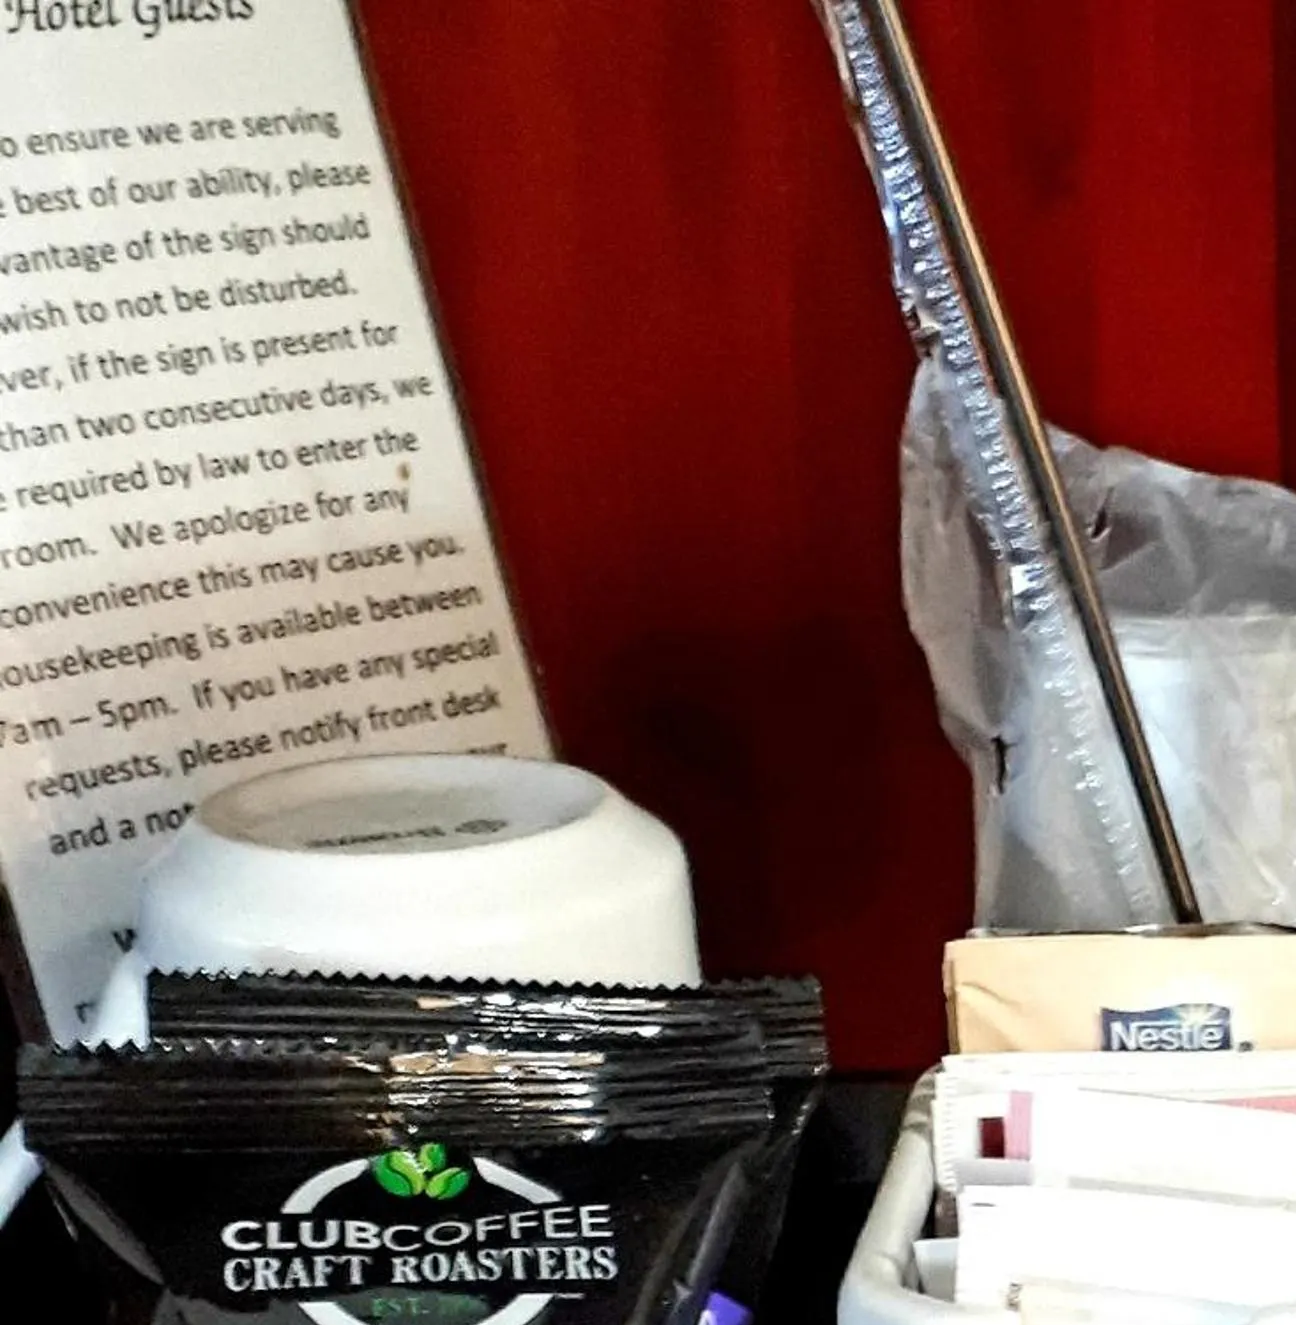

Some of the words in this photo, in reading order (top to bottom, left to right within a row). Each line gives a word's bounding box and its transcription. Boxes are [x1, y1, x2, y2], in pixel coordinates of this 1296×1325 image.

[5, 0, 121, 34] Hotel
[132, 0, 255, 40] Guests
[0, 137, 18, 158] o
[26, 127, 130, 155] ensure
[137, 123, 182, 145] we
[190, 118, 236, 141] are
[242, 107, 341, 139] serving
[12, 187, 82, 214] best
[89, 177, 117, 207] of
[128, 180, 176, 204] our
[187, 168, 281, 198] ability,
[287, 163, 370, 195] please
[0, 243, 117, 275] vantage
[126, 230, 153, 261] of
[162, 229, 212, 257] the
[219, 224, 275, 255] sign
[282, 213, 370, 245] should
[74, 294, 108, 325] to
[115, 291, 167, 318] not
[172, 286, 211, 312] be
[219, 269, 358, 307] disturbed.
[0, 366, 63, 394] ver,
[68, 353, 88, 383] if
[97, 350, 148, 379] the
[156, 344, 215, 375] sign
[220, 337, 246, 363] is
[252, 327, 357, 365] present
[361, 320, 397, 346] for
[76, 413, 136, 439] two
[144, 388, 314, 430] consecutive
[320, 381, 388, 408] days,
[393, 377, 431, 397] we
[15, 462, 149, 507] required
[153, 460, 191, 488] by
[198, 453, 250, 479] law
[256, 449, 289, 472] to
[295, 439, 367, 466] enter
[373, 428, 420, 456] the
[0, 537, 97, 569] room.
[110, 521, 166, 549] We
[174, 501, 311, 544] apologize
[315, 491, 354, 518] for
[364, 489, 408, 513] any
[197, 564, 253, 594] this
[258, 550, 318, 583] may
[327, 544, 404, 573] cause
[407, 537, 463, 565] you.
[0, 633, 202, 688] ousekeeping
[205, 624, 230, 649] is
[237, 602, 361, 644] available
[366, 586, 481, 621] between
[96, 696, 178, 730] 5pm.
[192, 679, 212, 709] If
[219, 678, 275, 710] you
[281, 664, 350, 691] have
[358, 655, 404, 679] any
[411, 632, 498, 672] special
[25, 756, 172, 800] requests,
[178, 734, 272, 778] please
[279, 711, 360, 749] notify
[367, 700, 437, 730] front
[442, 687, 500, 718] desk
[49, 817, 111, 855] and
[118, 819, 137, 840] a
[221, 1204, 615, 1251] CLUBCOFFEE
[223, 1254, 373, 1293] CRAFT
[391, 1246, 619, 1284] ROASTERS
